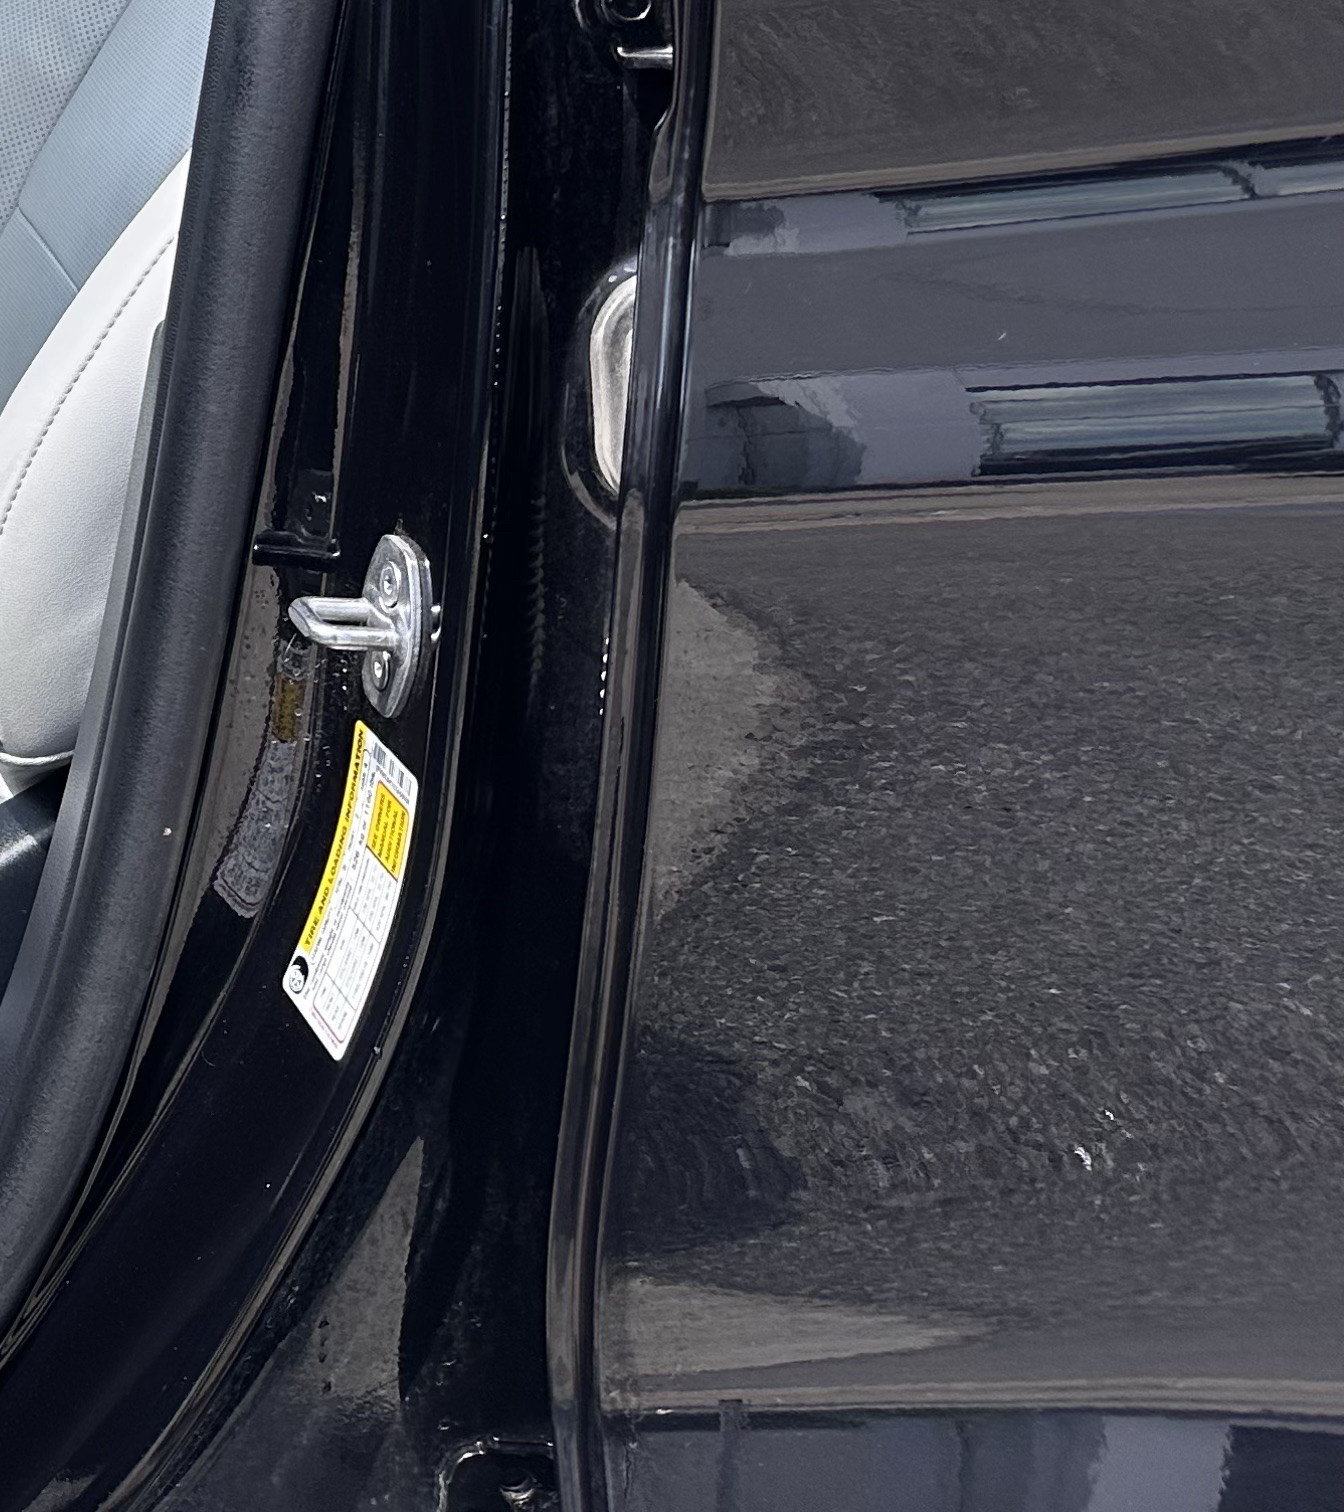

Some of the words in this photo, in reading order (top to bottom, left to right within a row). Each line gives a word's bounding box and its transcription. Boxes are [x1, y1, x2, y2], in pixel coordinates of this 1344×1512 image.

[304, 917, 321, 946] TIRE
[318, 889, 331, 913] AND
[327, 826, 347, 884] LOADING
[346, 729, 364, 823] INFORMATION
